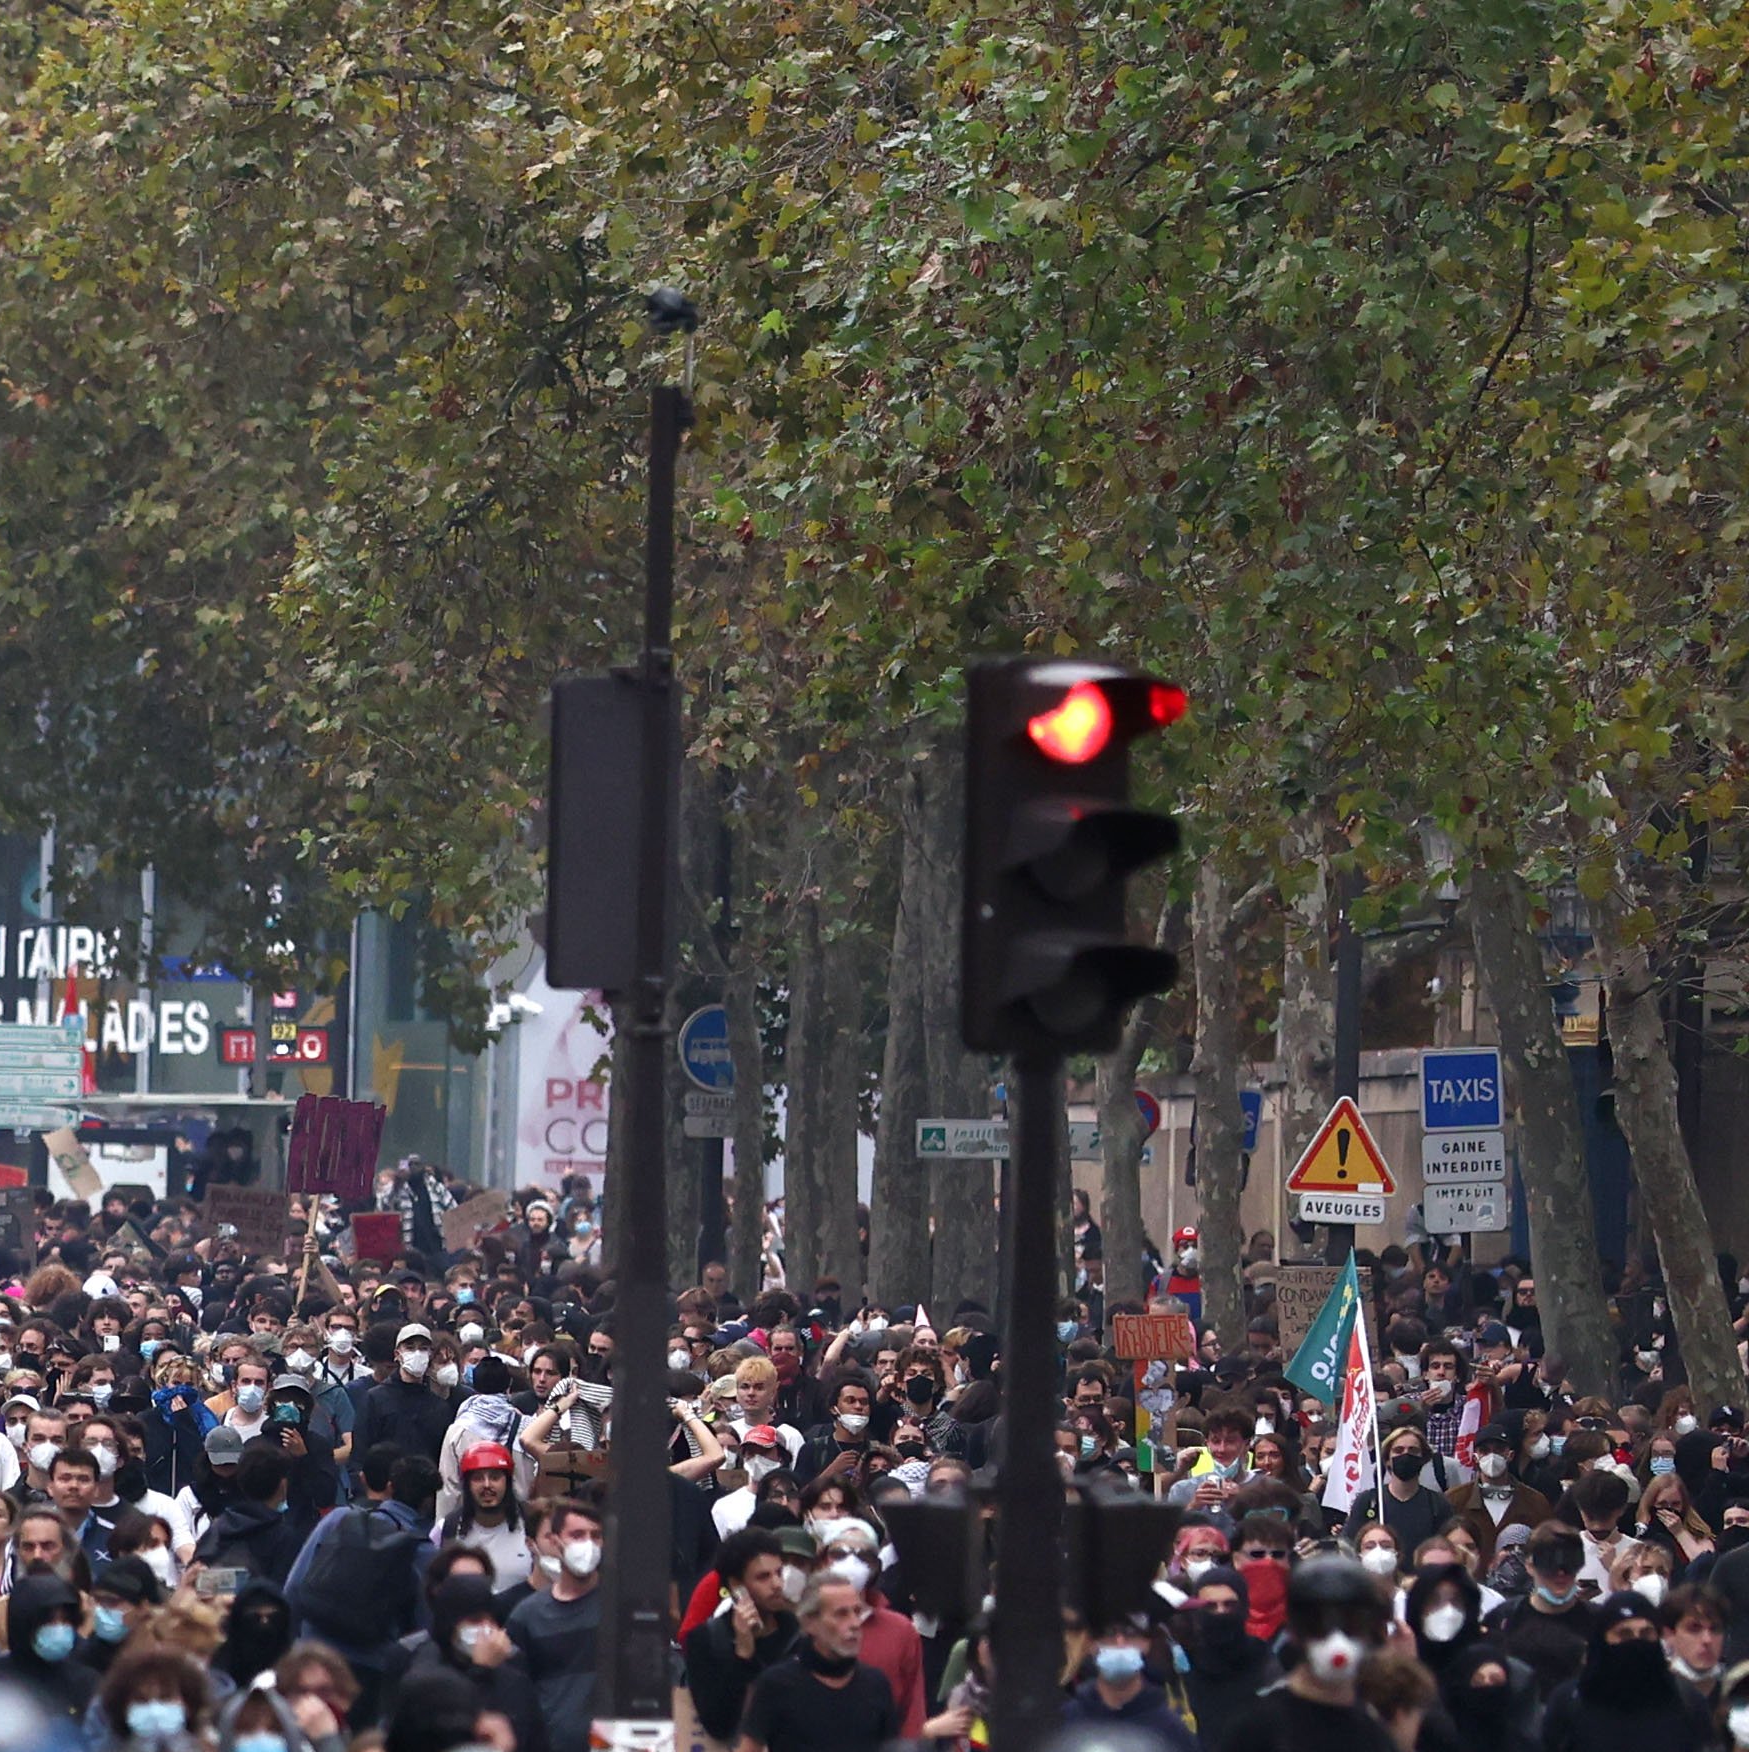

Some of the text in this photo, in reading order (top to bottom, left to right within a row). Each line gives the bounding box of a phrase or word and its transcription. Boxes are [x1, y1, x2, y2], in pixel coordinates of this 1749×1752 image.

[16, 997, 210, 1055] MLADES
[1428, 1077, 1495, 1104] TAXIS
[1441, 1141, 1487, 1154] GAINE
[1426, 1159, 1502, 1175] INTERDITE
[1304, 1201, 1382, 1217] AVEUGLES
